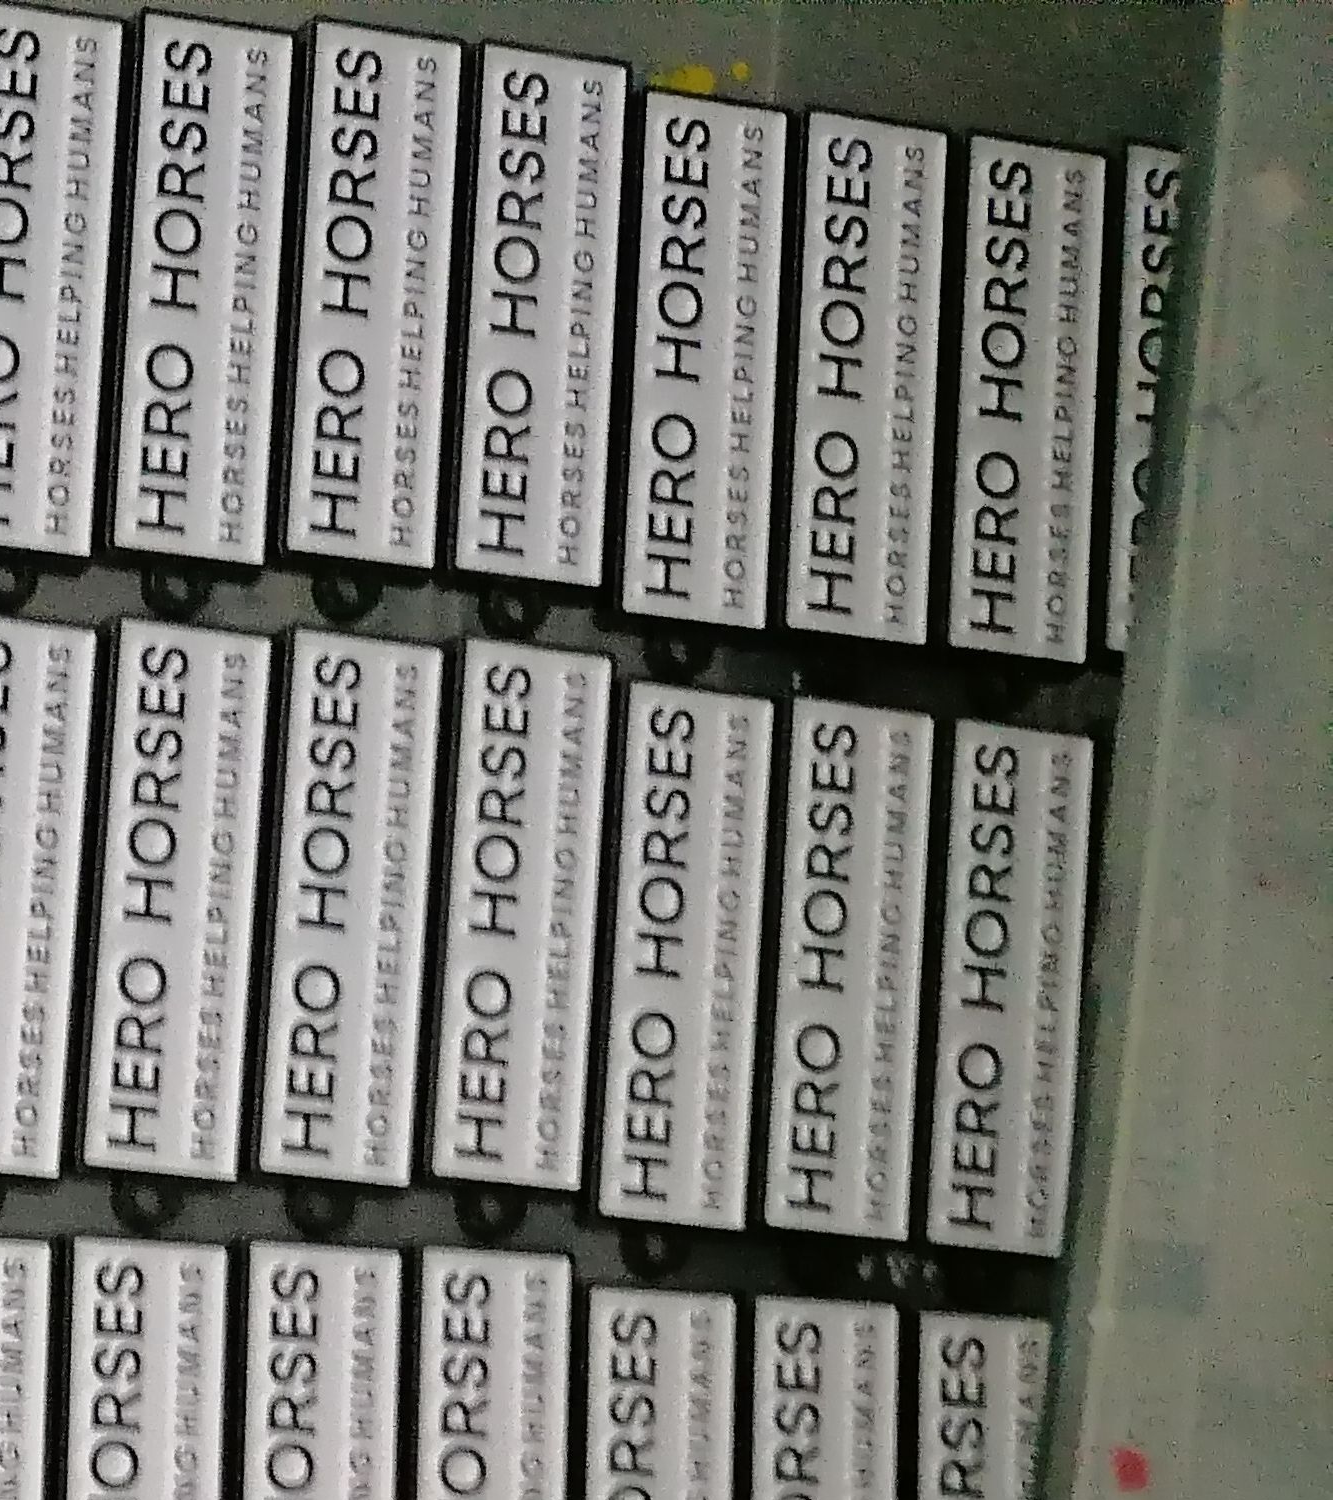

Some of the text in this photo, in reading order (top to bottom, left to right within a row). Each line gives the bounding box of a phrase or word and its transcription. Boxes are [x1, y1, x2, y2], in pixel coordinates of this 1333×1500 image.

[43, 35, 101, 535] HORSES HELPING HUMANS
[135, 36, 215, 535] HERO HORSES
[308, 44, 385, 538] HERO HORSES
[388, 55, 441, 547] HORSES HELPING HUMANS
[477, 67, 552, 557] HERO HORSES
[556, 77, 606, 565] HORSES HELPING HUMANS
[643, 113, 713, 600] HERO HORSES
[806, 132, 875, 616] HERO HORSES
[883, 143, 927, 624] HORSES HELPING HUMANS
[969, 156, 1035, 635] HERO HORSES
[106, 642, 192, 1151] HERO HORSES
[454, 660, 535, 1162] HERO HORSES
[786, 719, 861, 1213] HERO HORSES
[948, 741, 1022, 1229] HERO HORSES
